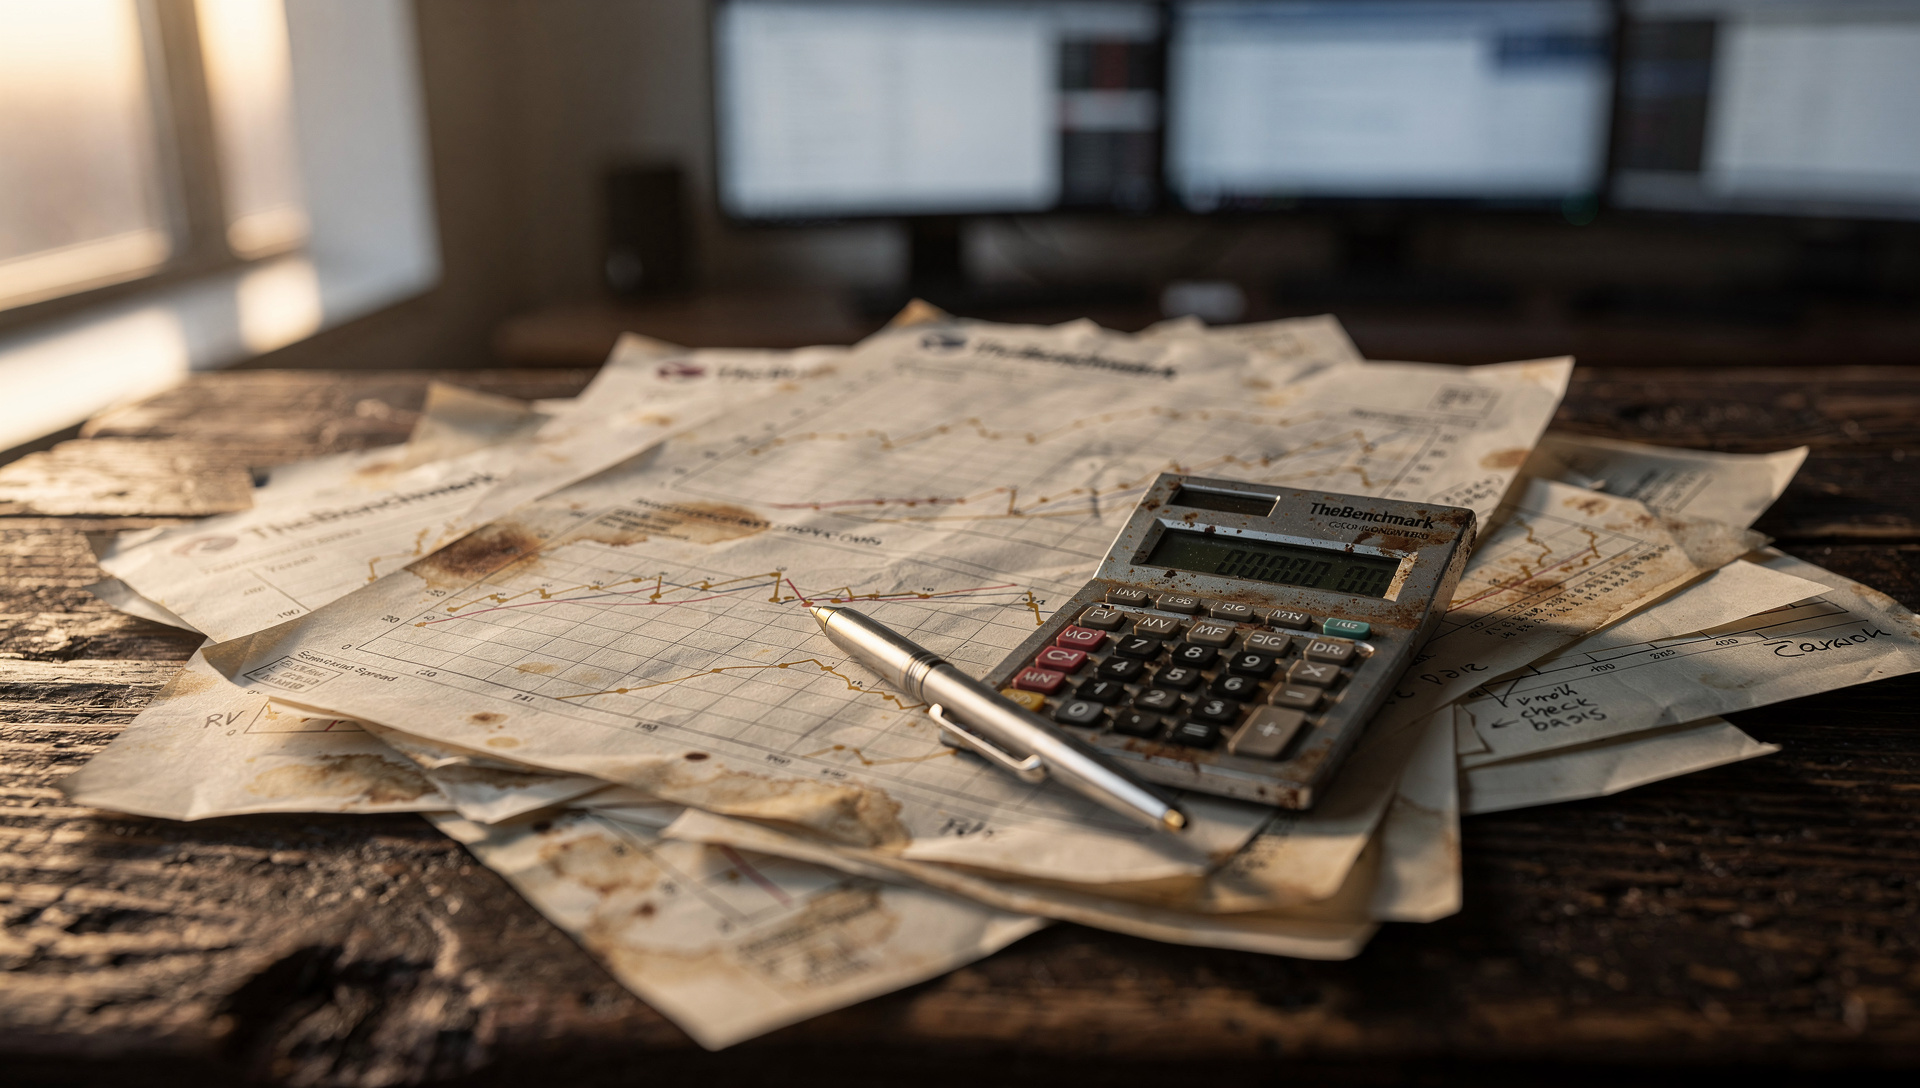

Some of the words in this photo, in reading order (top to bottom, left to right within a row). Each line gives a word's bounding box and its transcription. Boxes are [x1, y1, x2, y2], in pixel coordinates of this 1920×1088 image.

[1311, 502, 1435, 530] TheBenchmark
[1142, 617, 1171, 629] NV
[1195, 625, 1227, 636] MF
[1130, 639, 1149, 649] 7
[1184, 647, 1203, 658] 8
[1111, 661, 1129, 672] 4
[1241, 655, 1261, 667] 9
[355, 667, 398, 682] Spread
[1165, 668, 1187, 681] 5
[1093, 682, 1108, 694] 1
[1224, 677, 1244, 690] 6
[1143, 690, 1167, 705] 2
[1068, 702, 1088, 716] 0
[1203, 700, 1225, 715] 3
[1520, 698, 1598, 719] check
[203, 709, 245, 729] RV
